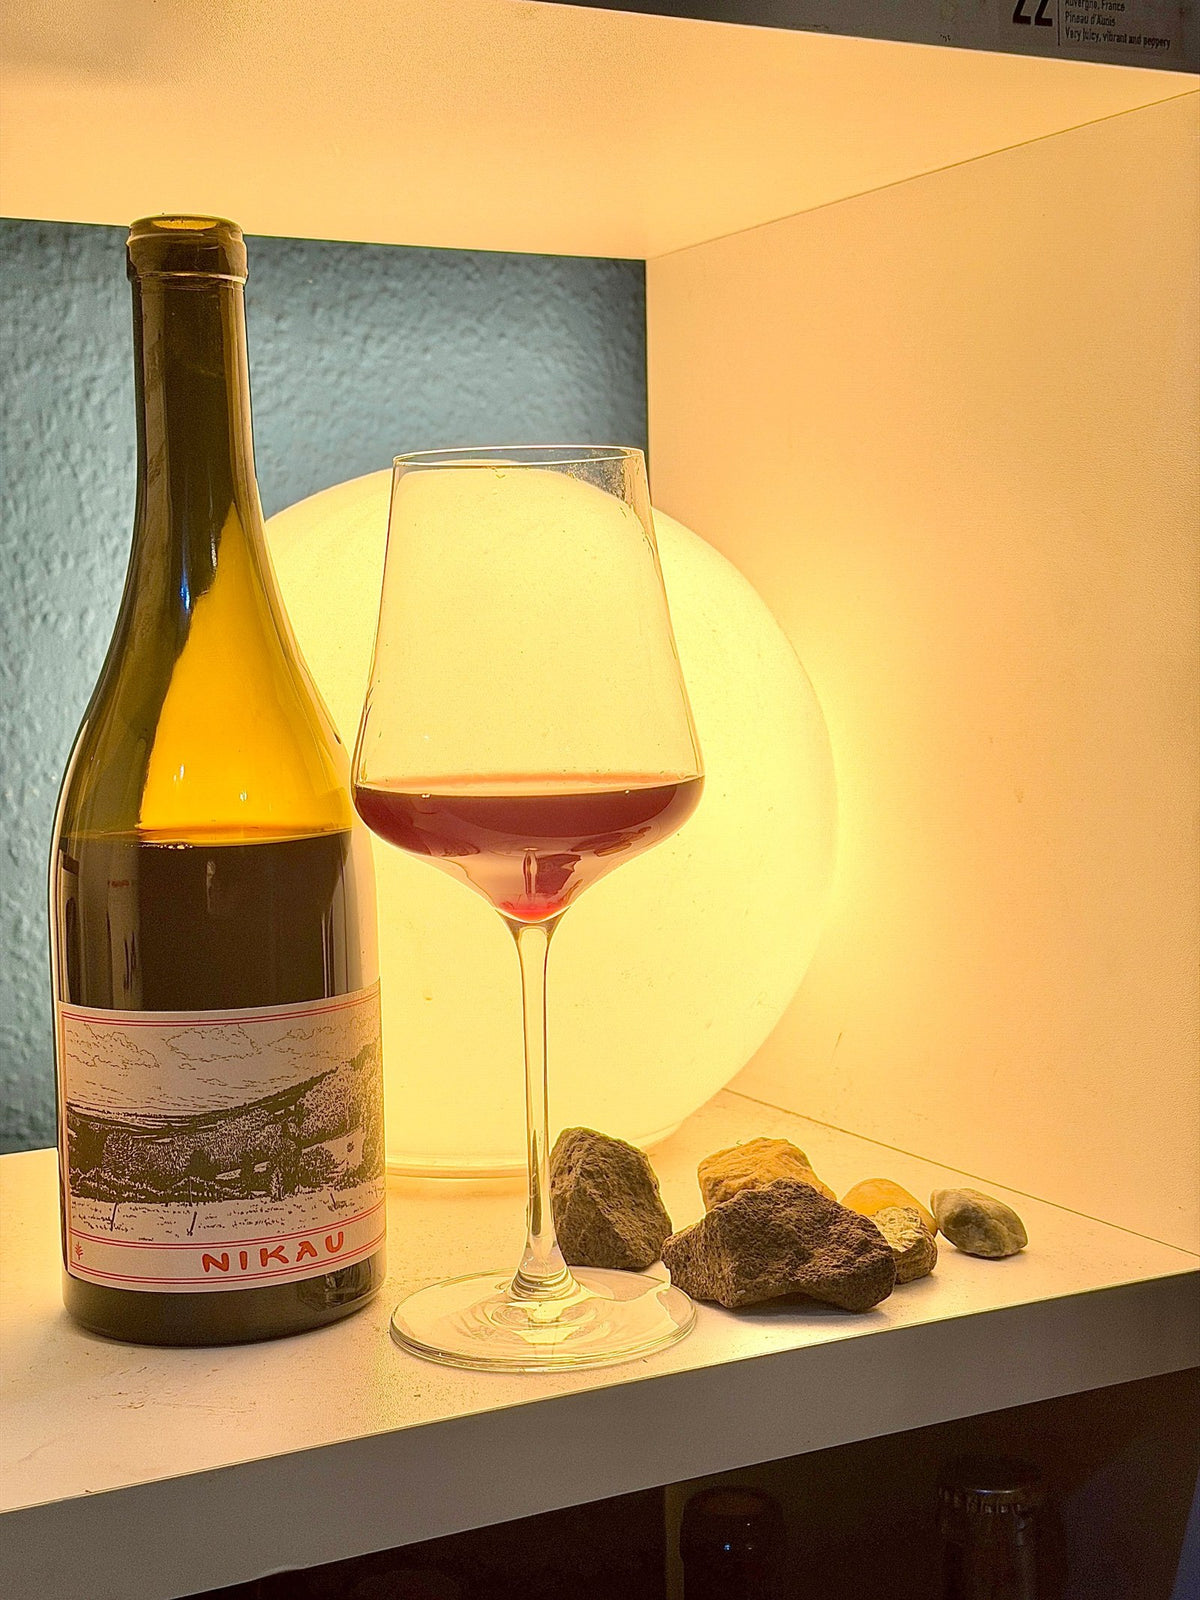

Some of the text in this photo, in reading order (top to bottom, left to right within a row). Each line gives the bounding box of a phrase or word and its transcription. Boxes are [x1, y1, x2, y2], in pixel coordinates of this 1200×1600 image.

[1065, 10, 1116, 27] Pineau d'Aunis
[1065, 26, 1081, 41] Very
[1102, 30, 1127, 44] vibrant
[1128, 33, 1141, 45] and
[1142, 36, 1171, 51] peppery
[202, 1231, 344, 1273] NIKAU
